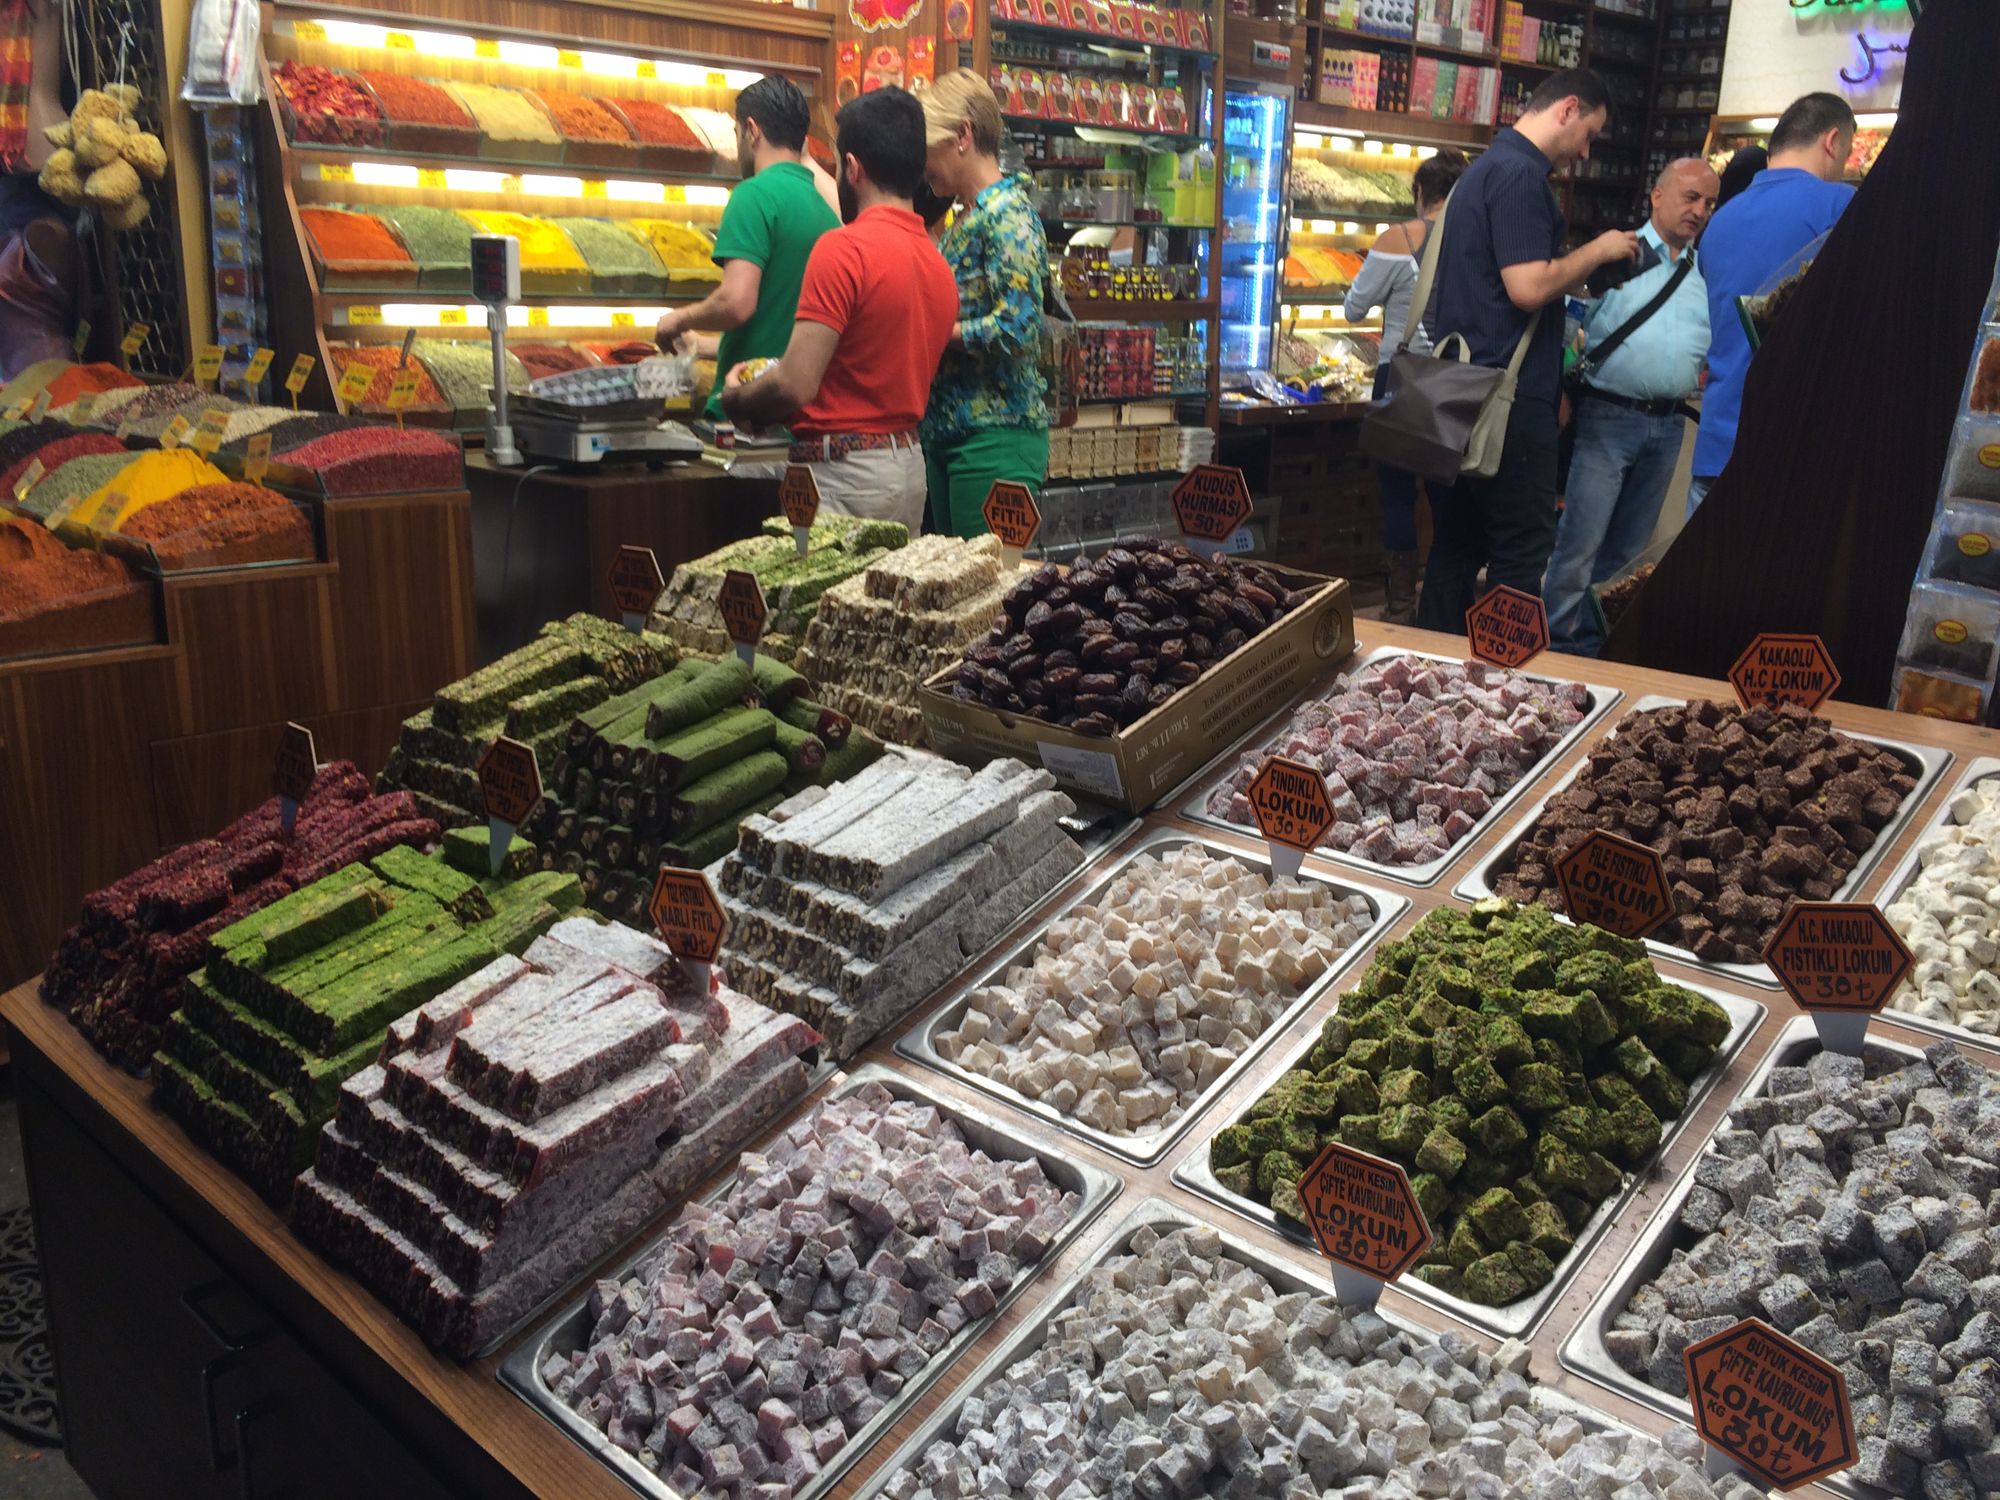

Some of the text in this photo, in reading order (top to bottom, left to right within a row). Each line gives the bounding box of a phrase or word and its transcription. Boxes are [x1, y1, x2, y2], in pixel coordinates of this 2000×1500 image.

[1180, 491, 1240, 517] HURMASI
[1507, 624, 1539, 650] LOKUM
[1759, 647, 1814, 669] KAKAOLU
[1771, 671, 1823, 691] LOKUM
[1270, 768, 1316, 801] FINDIKLI
[1258, 788, 1325, 826] LOKUM
[1274, 816, 1293, 834] 30
[1568, 862, 1657, 917] LOKUM
[660, 906, 691, 929] NARLI
[1587, 898, 1618, 923] 30
[1822, 920, 1872, 945] KAKAOLU
[1782, 946, 1893, 975] FISTIKLI LOKUM
[1795, 976, 1811, 986] KG
[1816, 976, 1851, 998] 30
[1347, 1183, 1406, 1228] KAVRULMUŞ
[1315, 1196, 1408, 1251] LOKUM
[1322, 1222, 1336, 1236] KG
[1336, 1231, 1369, 1261] 30
[1702, 1369, 1826, 1464] LOKUM
[1754, 1369, 1834, 1437] KAVRULMUŞ
[1706, 1399, 1726, 1418] KG
[1721, 1415, 1769, 1459] 30
